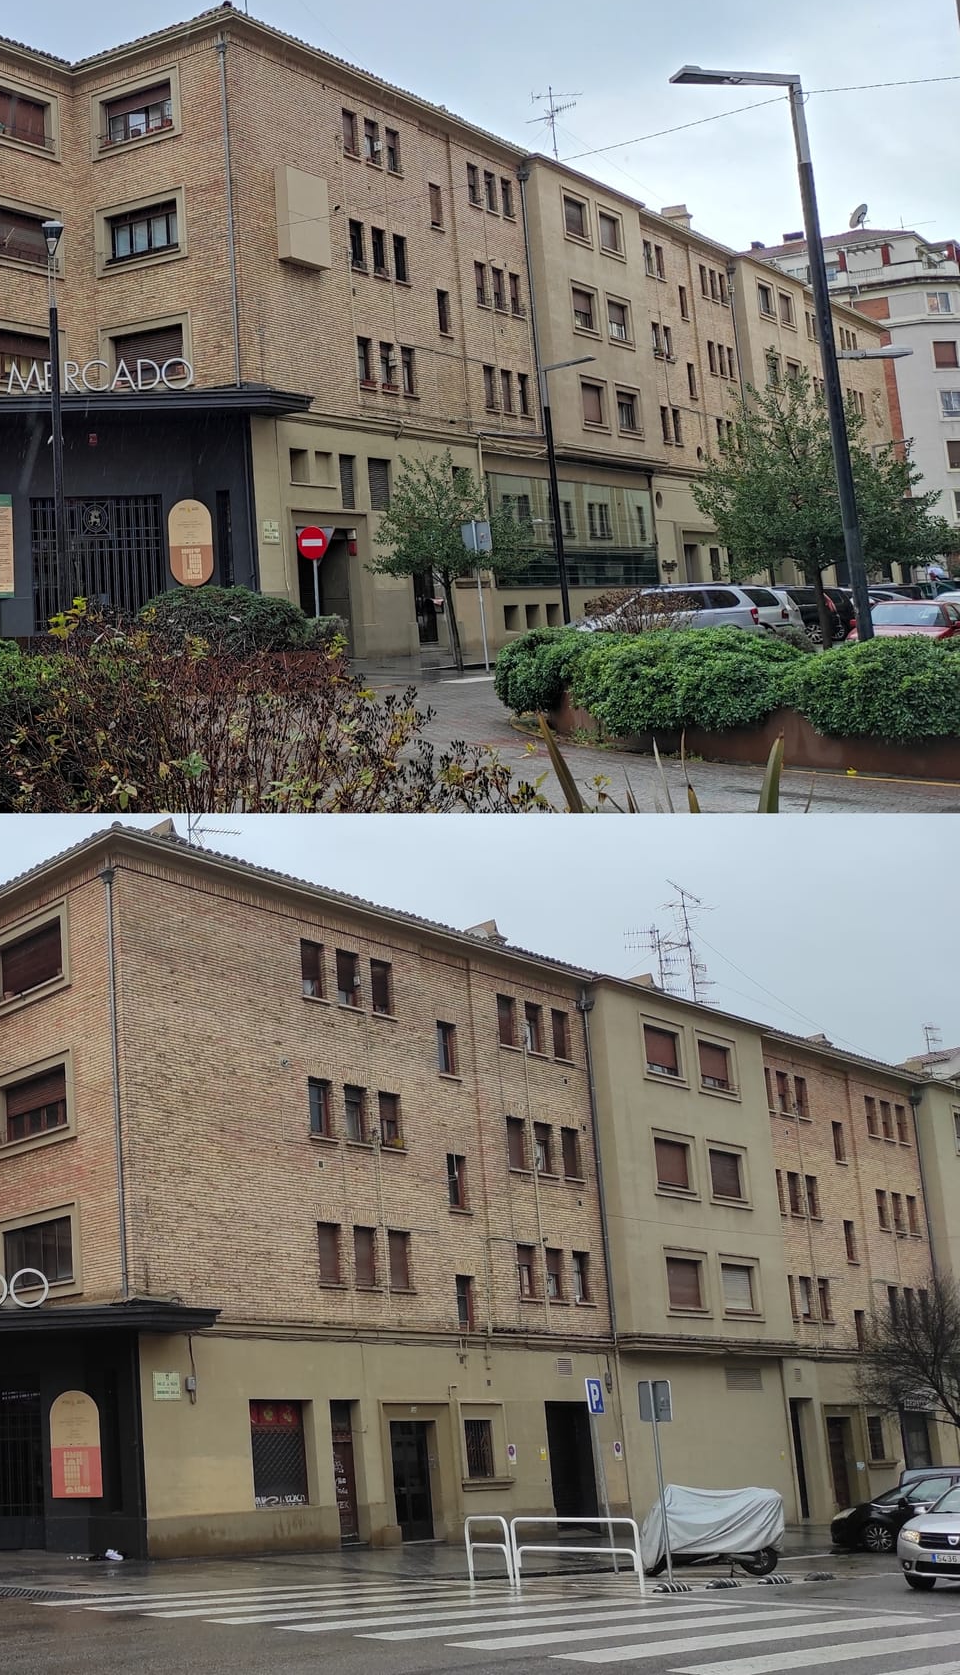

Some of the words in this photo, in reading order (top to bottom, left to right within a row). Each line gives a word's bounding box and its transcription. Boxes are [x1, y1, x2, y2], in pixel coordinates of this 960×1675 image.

[7, 357, 194, 394] MERCADO
[590, 1383, 600, 1410] P
[937, 1554, 958, 1563] 5436
